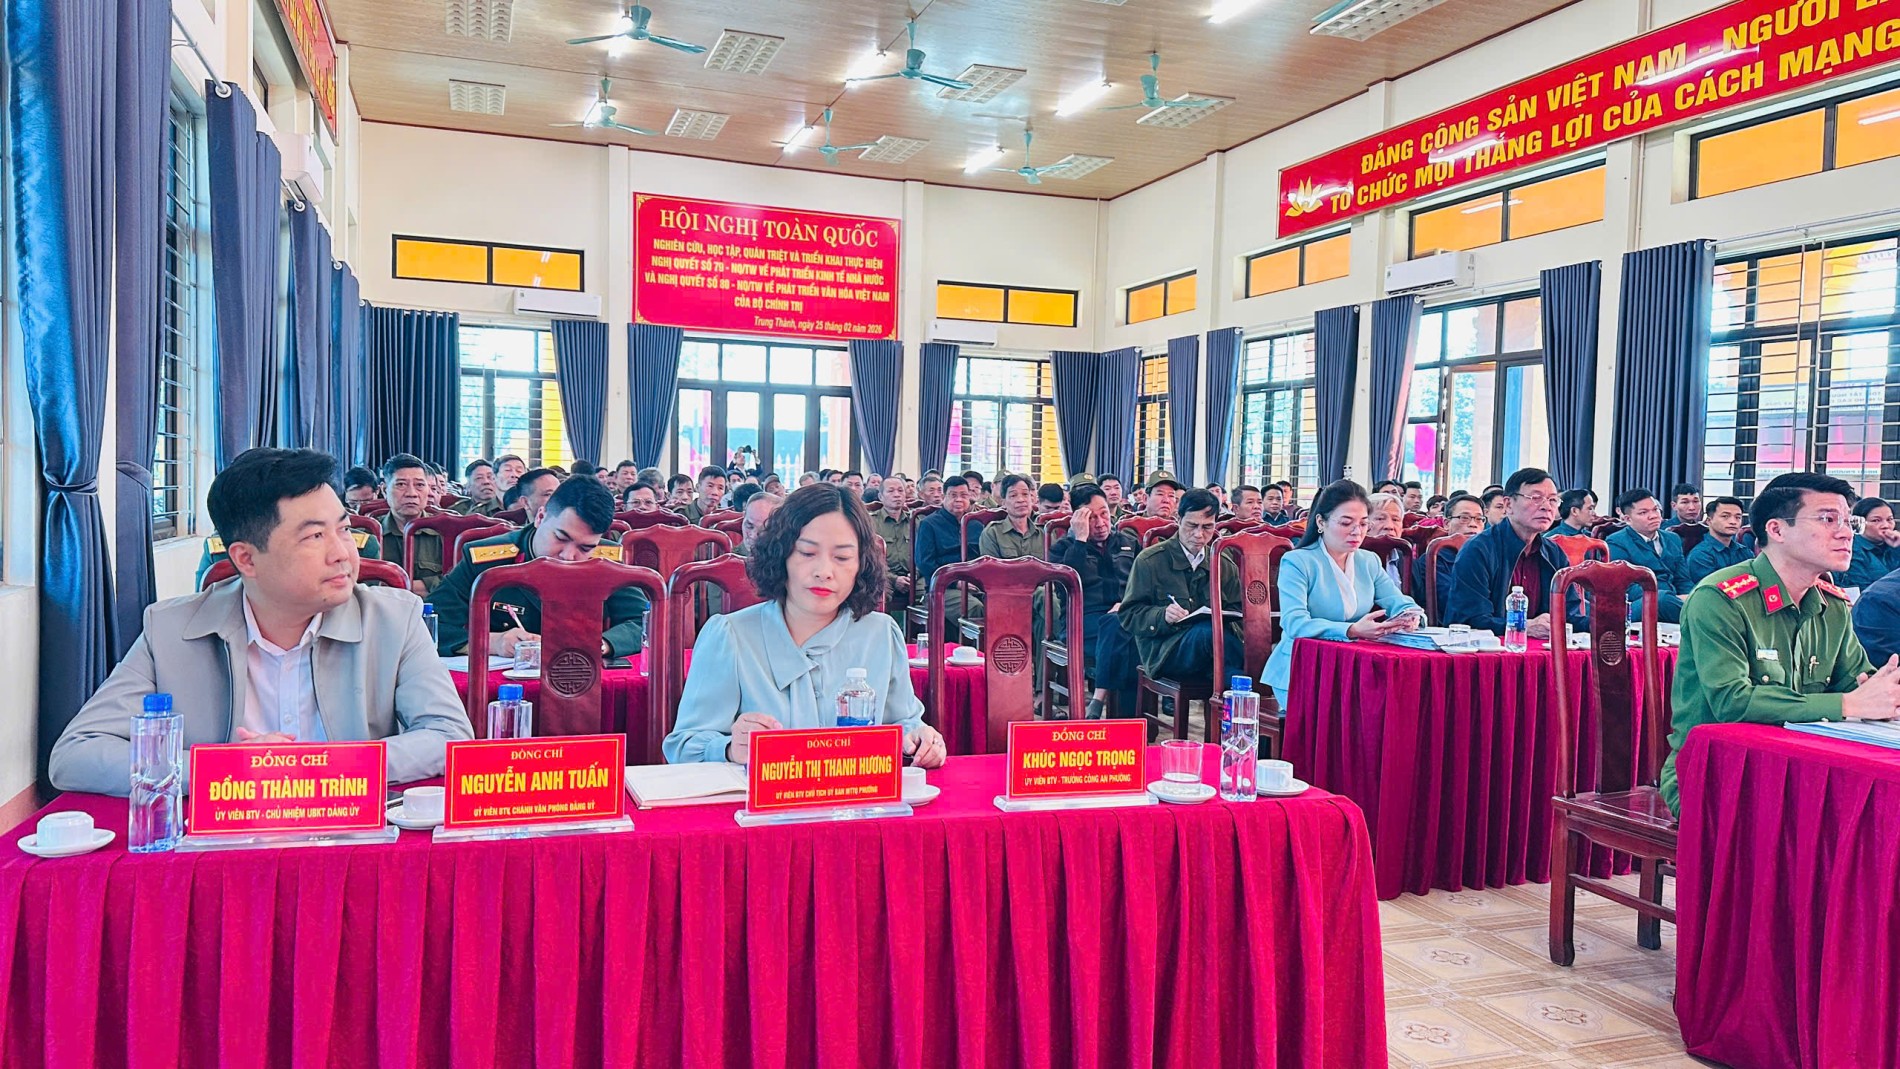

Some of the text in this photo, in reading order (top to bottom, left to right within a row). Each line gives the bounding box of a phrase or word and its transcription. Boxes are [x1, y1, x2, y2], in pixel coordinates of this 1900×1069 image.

[1357, 171, 1408, 205] CHỨC
[1414, 158, 1455, 186] MỌI
[1463, 130, 1542, 173] THẮNG
[1551, 113, 1593, 148] LỢI
[1602, 90, 1663, 132] CỦA
[1674, 60, 1764, 111] CÁCH
[1778, 18, 1900, 82] MẠNG
[1361, 142, 1414, 174] ĐẢNG
[1420, 115, 1479, 154] CỘNG
[1487, 94, 1537, 132] SẢN
[1547, 73, 1603, 112] VIỆT
[1613, 43, 1686, 90] NAM
[660, 206, 878, 248] HỘI NGHỊ TOÀN QUỐC
[653, 238, 883, 271] NGHIÊN CỨU, HỌC TẬP, QUÁN TRIỆT VÀ TRIỂN KHAI THỰC HIỆN
[651, 255, 672, 269] NGHỊ
[673, 257, 699, 270] QUYẾT
[701, 258, 712, 271] SỐ
[714, 261, 724, 272] 79
[731, 262, 757, 275] NQ/TW
[759, 263, 769, 276] VỀ
[770, 266, 790, 278] PHÁT
[792, 266, 814, 280] TRIỂN
[816, 270, 834, 281] KINH
[836, 269, 845, 282] TẾ
[846, 272, 862, 284] NHÀ
[864, 273, 884, 285] NƯỚC
[645, 270, 656, 283] VÀ
[658, 273, 678, 287] NGHỊ
[680, 274, 705, 287] QUYẾT
[707, 275, 718, 288] SỐ
[719, 278, 730, 290] 80
[737, 280, 762, 292] NQ/TW
[764, 280, 774, 293] VỀ
[775, 283, 795, 295] PHÁT
[798, 283, 819, 297] TRIỂN
[821, 285, 836, 298] VĂN
[838, 287, 854, 300] HÓA
[855, 289, 870, 302] VIỆT
[872, 291, 890, 302] NAM
[734, 293, 803, 313] CỦA BỘ CHÍNH TRỊ
[754, 315, 882, 334] Trung Thành, ngày 25 tháng 02 năm 2026
[807, 736, 850, 749] ĐỒNG CHÍ
[1052, 727, 1105, 741] ĐỒNG CHÍ
[251, 750, 329, 767] ĐỒNG CHÍ
[511, 746, 563, 760] ĐỒNG CHÍ
[1023, 749, 1135, 771] KHÚC NGỌC TRỌNG
[461, 761, 609, 796] NGUYỄN ANH TUẤN
[761, 754, 892, 782] NGUYỄN THỊ THANH HƯƠNG
[1033, 775, 1046, 785] VIÊN
[1047, 776, 1057, 785] BTV
[1084, 773, 1099, 784] CÔNG
[1100, 774, 1108, 783] AN
[1109, 773, 1131, 783] PHƯỜNG
[209, 774, 368, 801] ĐỒNG THÀNH TRÌNH
[227, 808, 244, 820] VIÊN
[246, 810, 260, 820] BTV
[265, 805, 281, 819] CHỦ
[282, 806, 305, 821] NHIỆM
[307, 807, 326, 818] UBKT
[327, 803, 348, 817] ĐẢNG
[483, 805, 498, 816] VIÊN
[512, 804, 533, 815] CHÁNH
[534, 803, 546, 813] VĂN
[547, 802, 568, 812] PHÒNG
[569, 800, 586, 811] ĐẢNG
